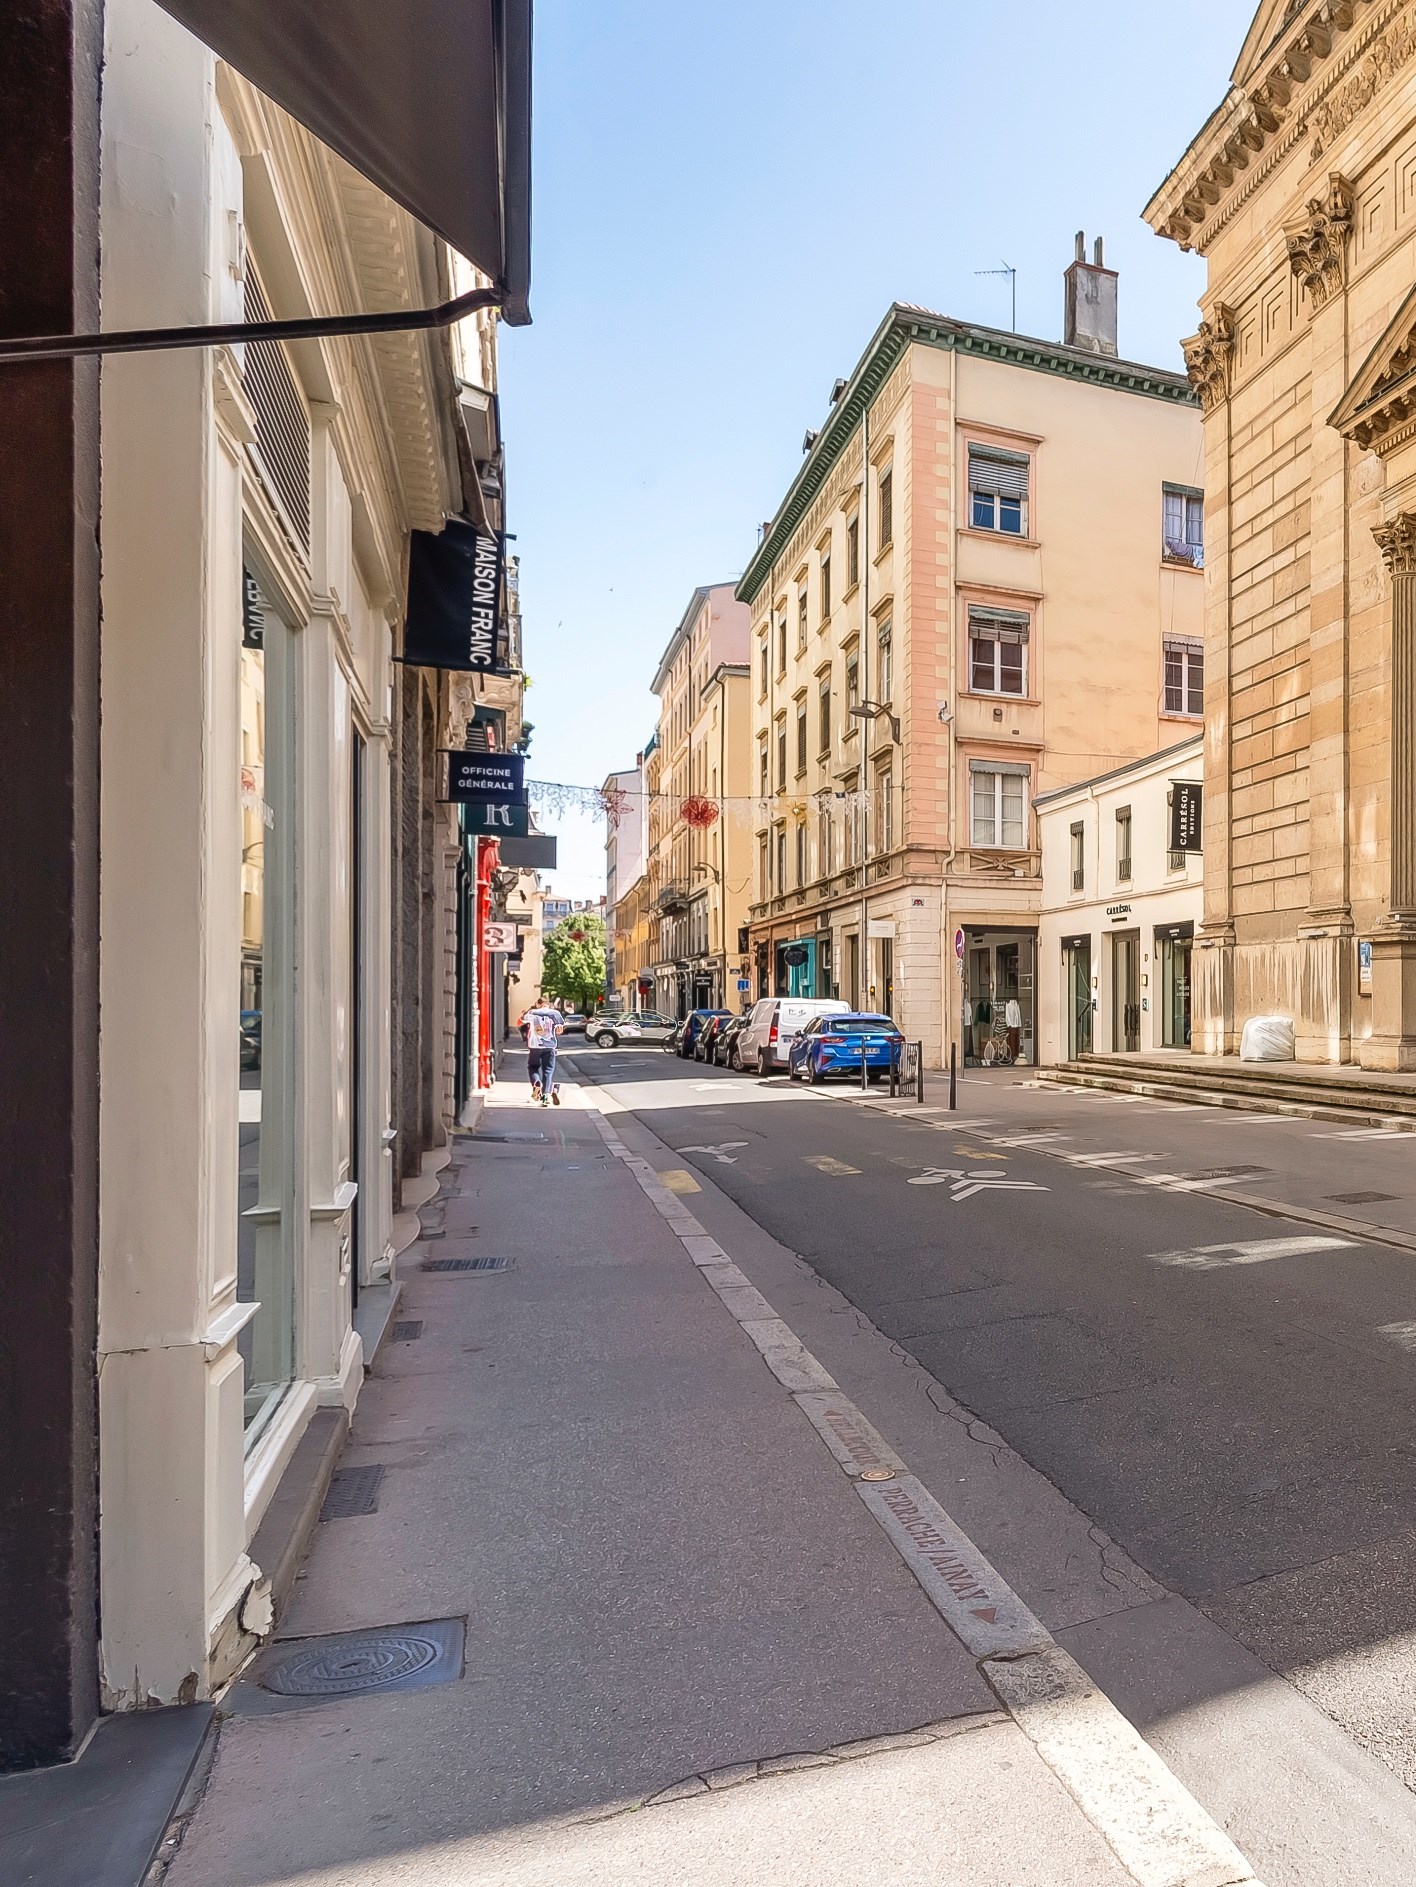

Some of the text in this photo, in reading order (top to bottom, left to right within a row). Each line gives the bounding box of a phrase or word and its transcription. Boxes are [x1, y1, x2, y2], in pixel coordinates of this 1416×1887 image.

[469, 536, 498, 666] MAISON FRANC
[458, 779, 515, 791] GÉNÉRALE
[461, 766, 511, 777] OFFICINE
[1179, 788, 1189, 846] CARRÉSOL
